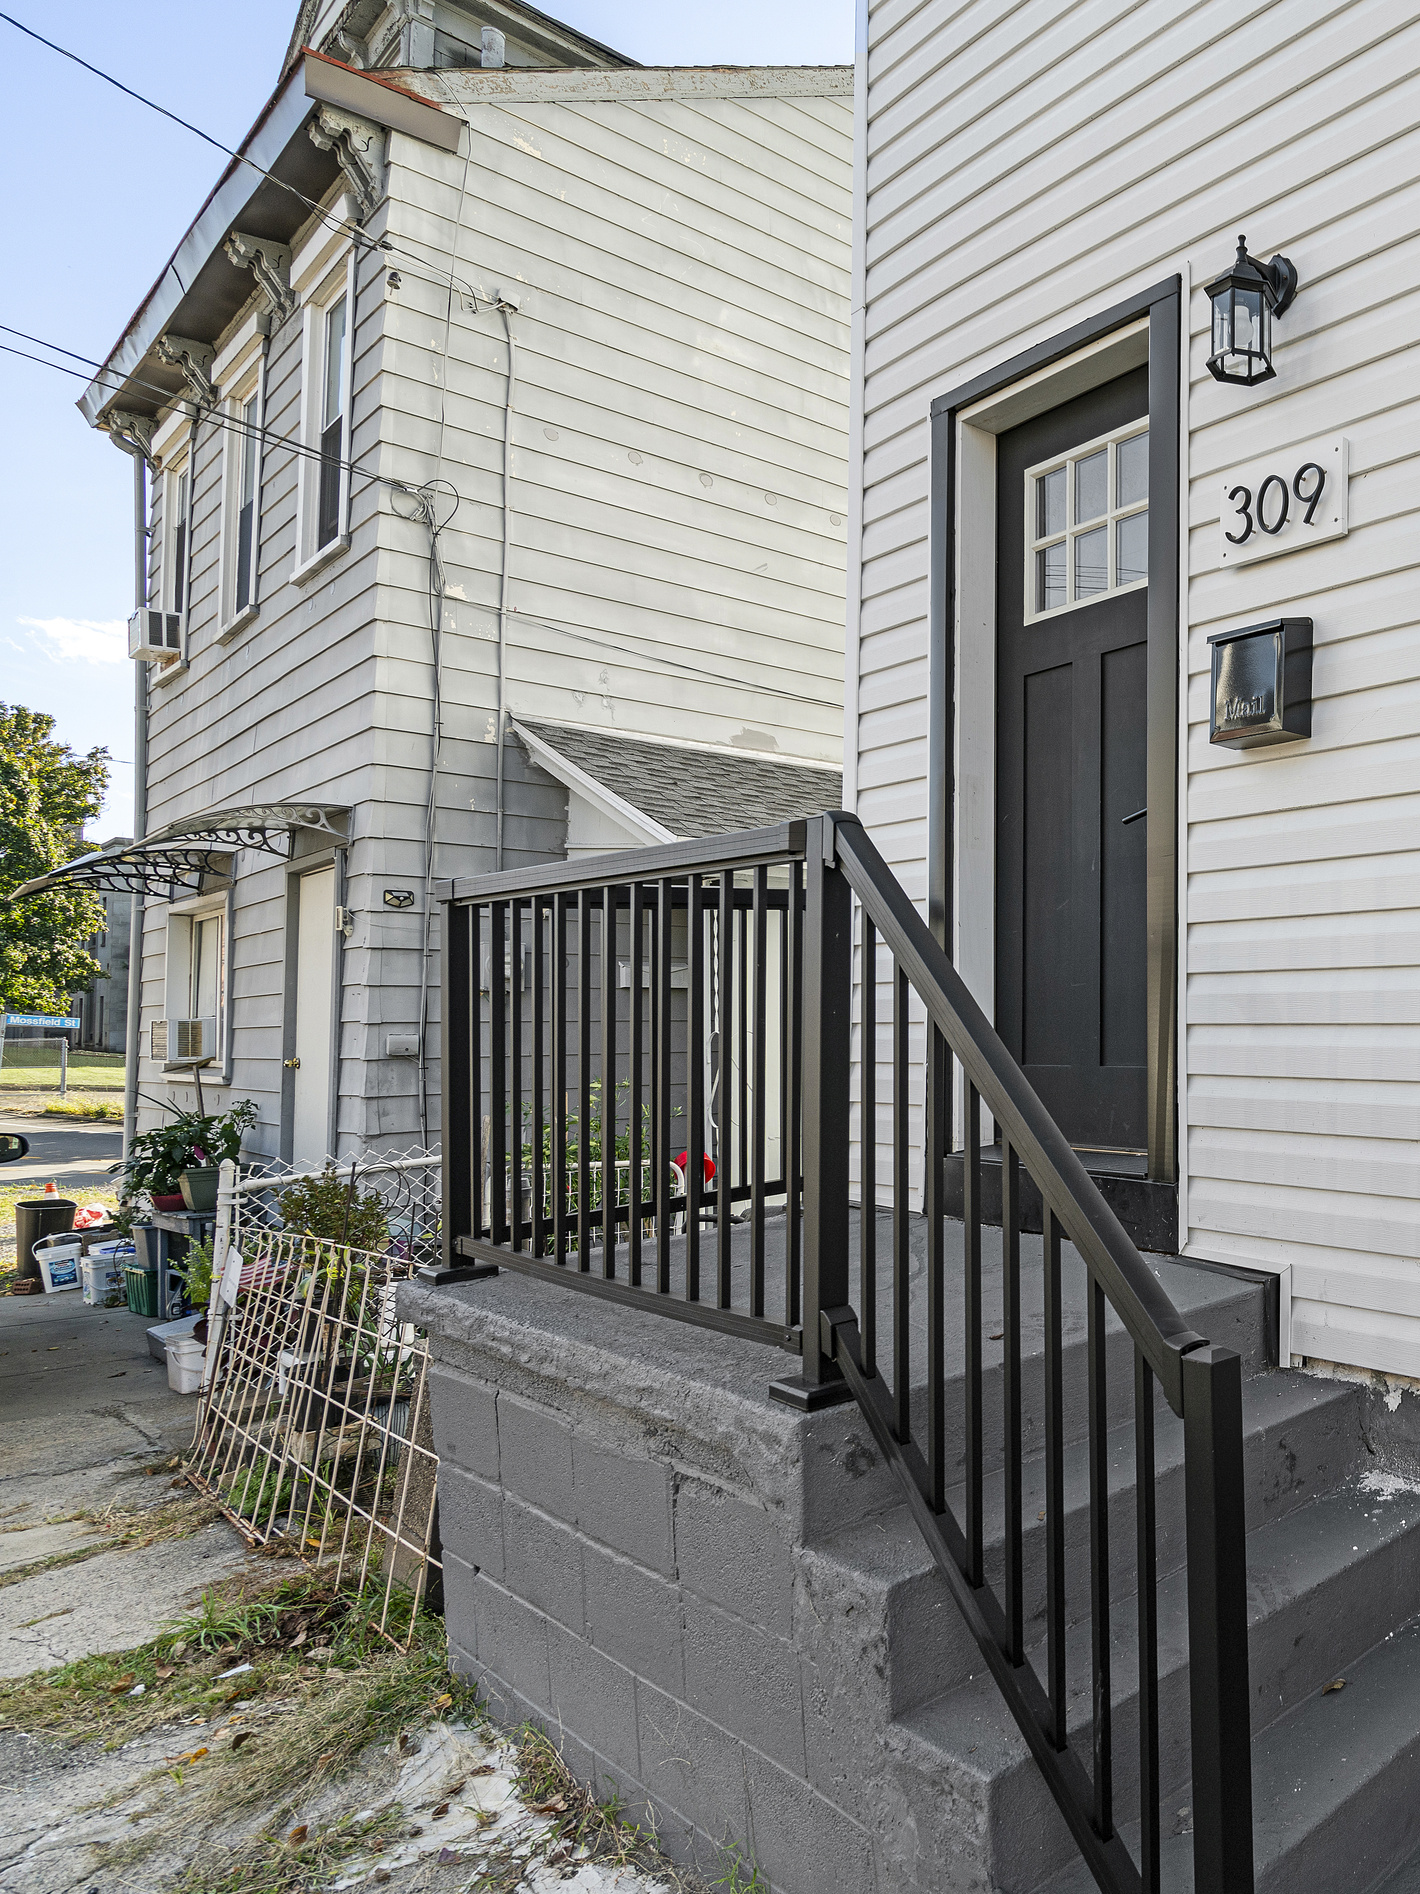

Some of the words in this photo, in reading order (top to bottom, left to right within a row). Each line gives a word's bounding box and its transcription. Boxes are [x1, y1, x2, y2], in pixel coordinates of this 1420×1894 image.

[1225, 462, 1326, 545] 309
[1224, 694, 1266, 721] Mail
[9, 1016, 60, 1026] Mossfield
[64, 1019, 76, 1027] St
